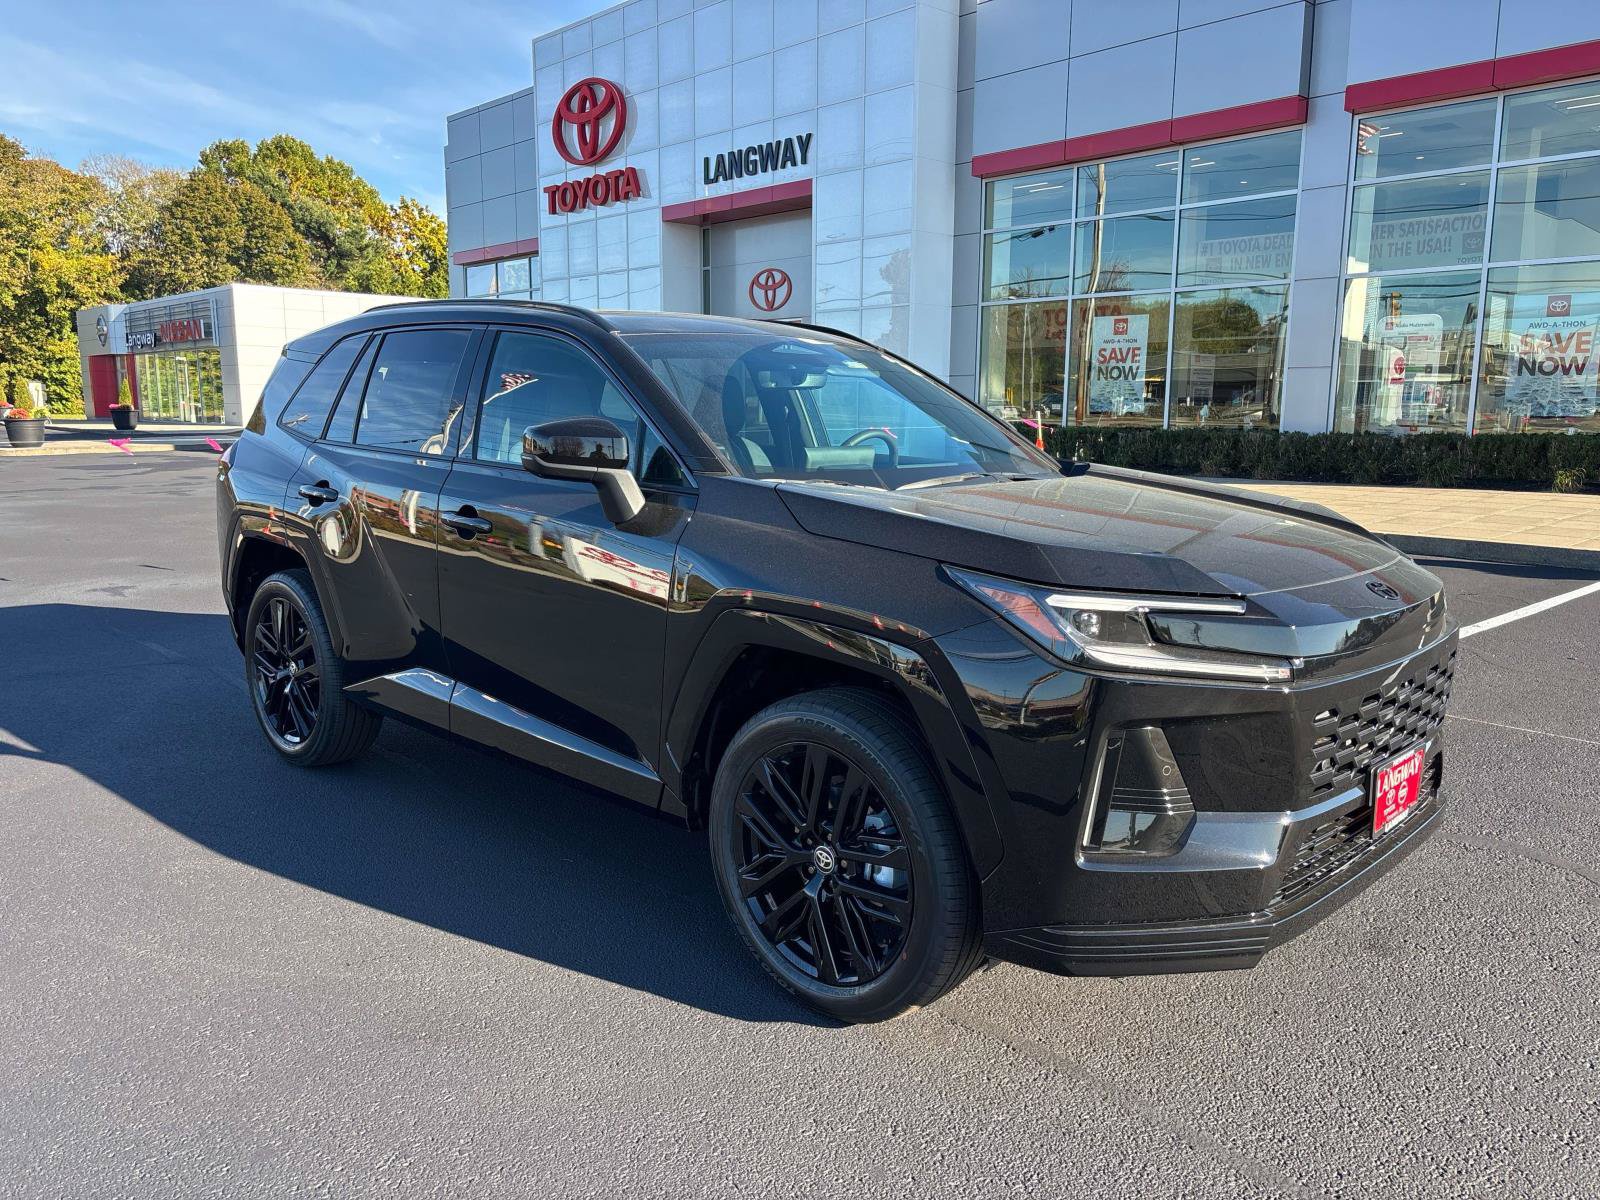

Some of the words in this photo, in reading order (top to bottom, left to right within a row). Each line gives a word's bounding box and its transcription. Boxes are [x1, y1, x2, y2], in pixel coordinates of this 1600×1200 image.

[703, 132, 812, 185] LANGWAY
[544, 167, 640, 215] TOYOTA
[1400, 213, 1487, 238] SATISFACTIO
[1200, 242, 1213, 257] #1
[1219, 238, 1260, 254] TOYOTA
[1388, 241, 1412, 257] THE
[1417, 236, 1452, 256] USA!!
[1231, 257, 1242, 271] IN
[1247, 253, 1271, 270] NEW
[160, 319, 204, 343] NISSAN
[1528, 320, 1587, 330] AWD-A-THON
[1519, 331, 1592, 356] SAVE
[1097, 346, 1141, 365] SAVE
[1517, 355, 1590, 377] NOW
[1097, 365, 1140, 381] NOW
[1377, 755, 1422, 798] LANGWAY
